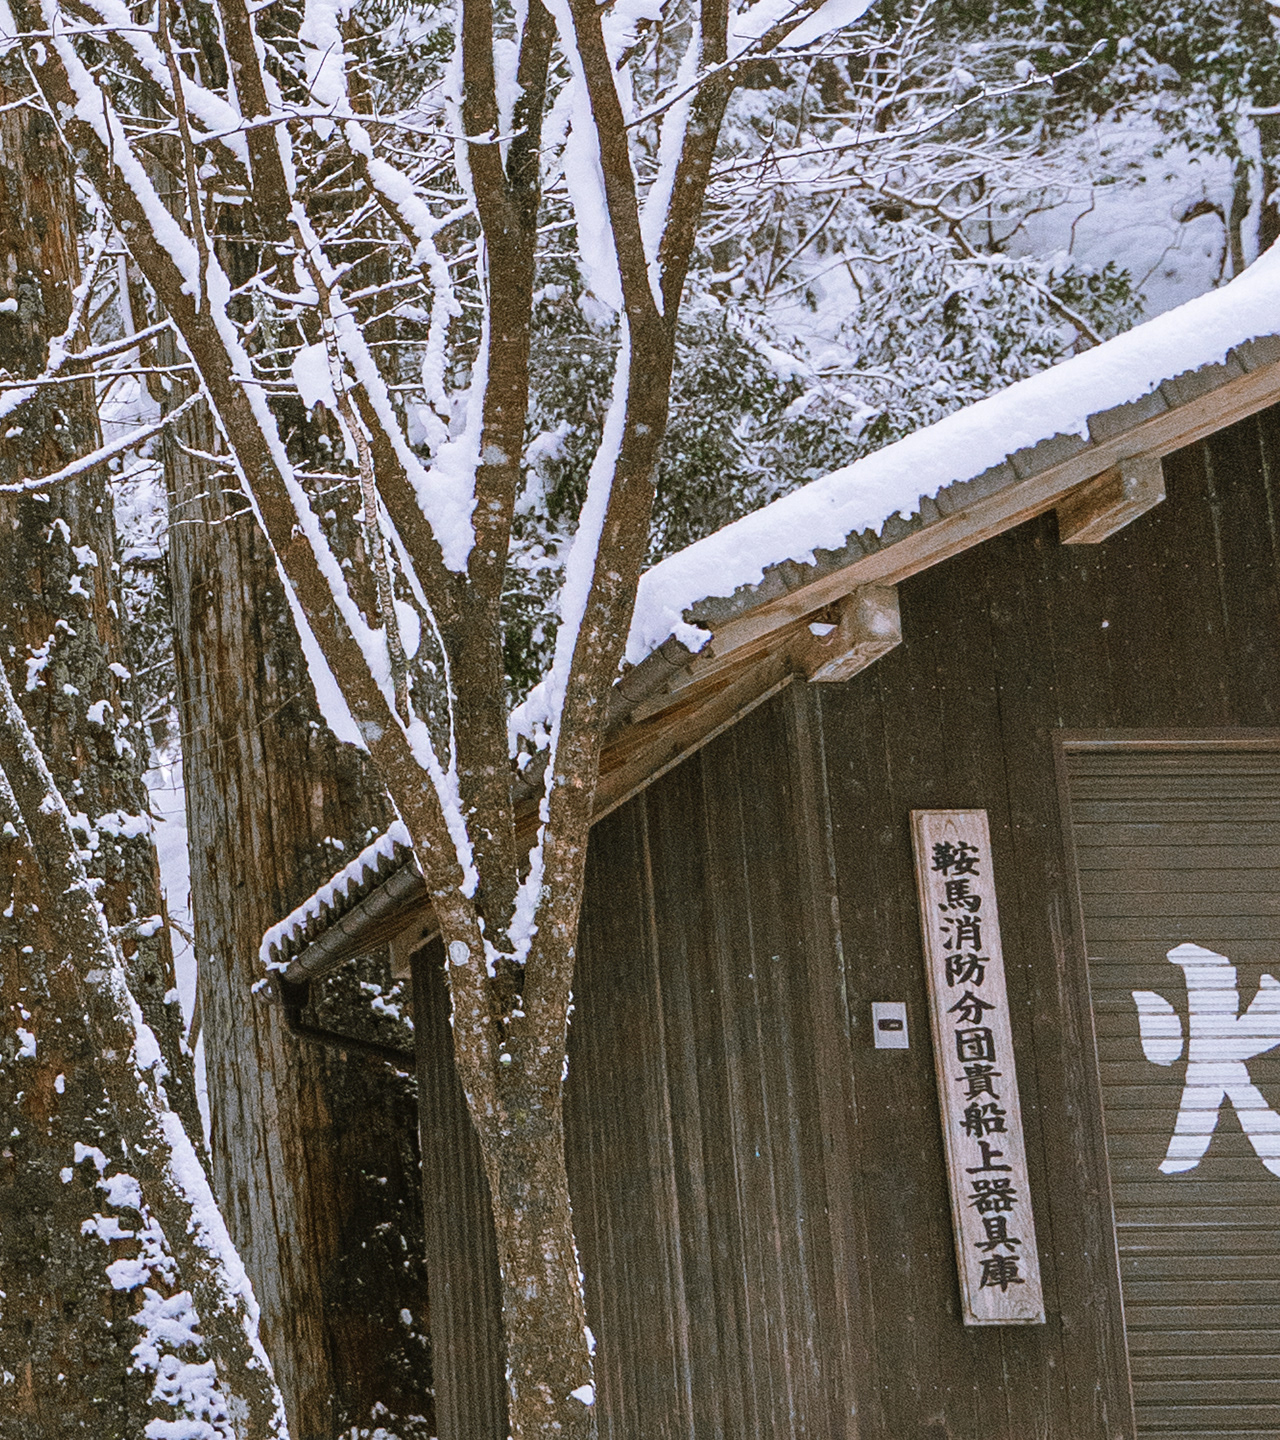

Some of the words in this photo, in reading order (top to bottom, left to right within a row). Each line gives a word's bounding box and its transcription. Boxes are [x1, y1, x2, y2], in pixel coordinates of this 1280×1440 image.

[931, 840, 1025, 1293] 鞍馬消防分団貴船上器具庫
